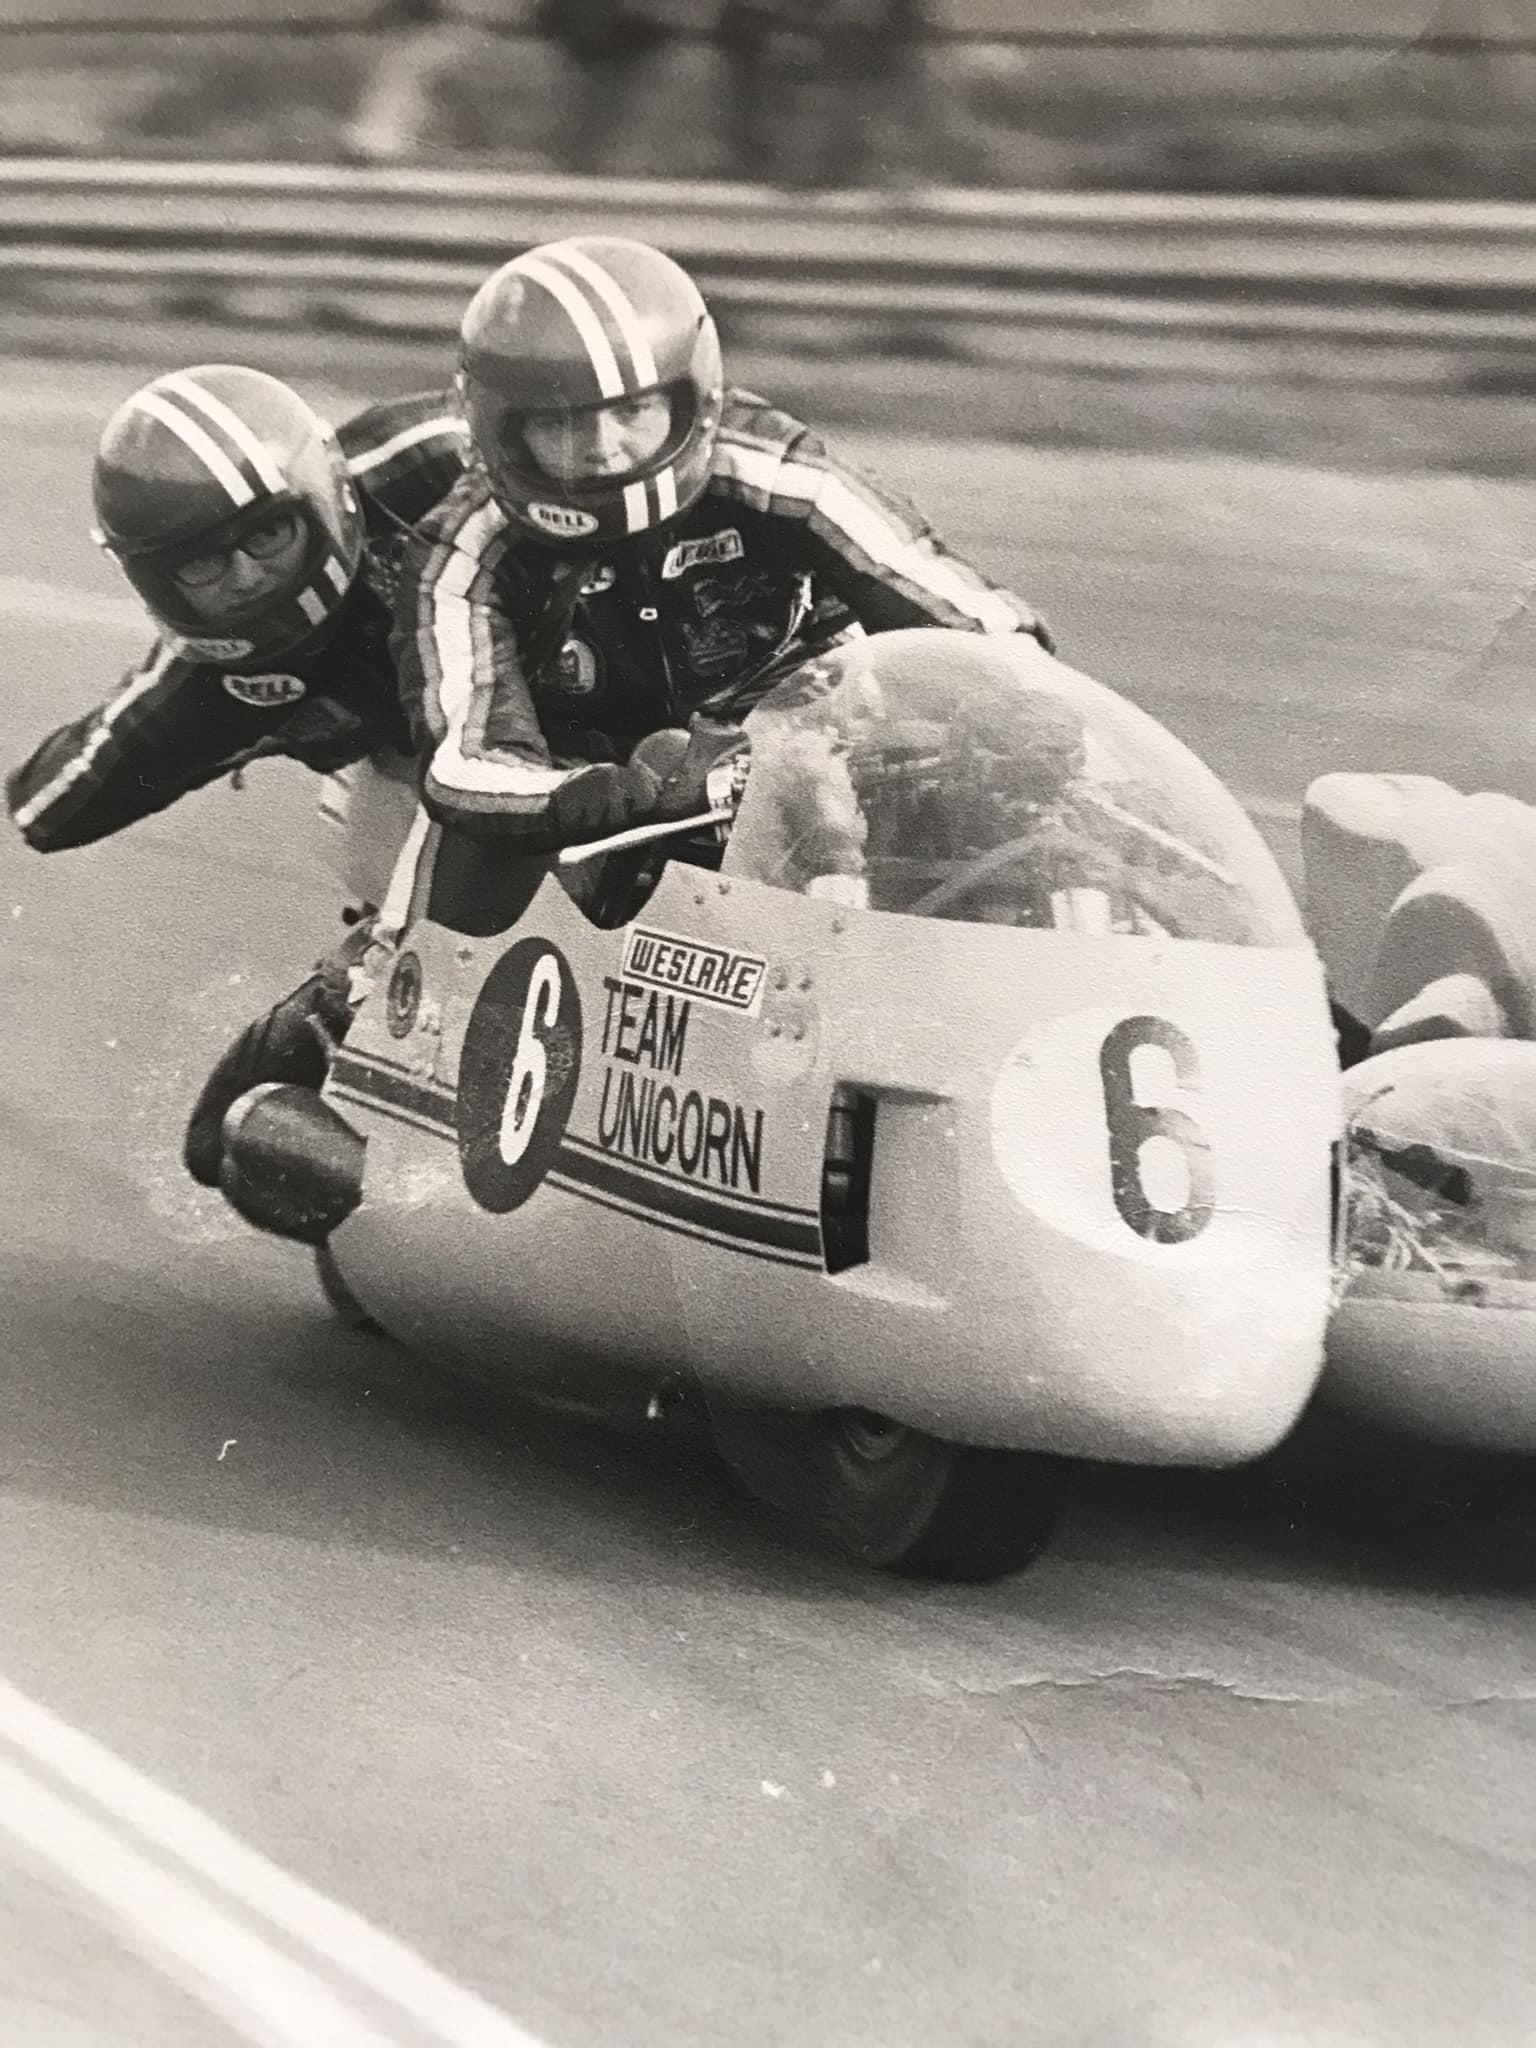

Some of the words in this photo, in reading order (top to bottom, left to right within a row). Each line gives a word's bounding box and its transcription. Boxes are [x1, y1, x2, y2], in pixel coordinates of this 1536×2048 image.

[602, 976, 690, 1076] TEAM
[630, 938, 757, 1000] WESLAKE
[500, 954, 561, 1164] 6
[598, 1067, 764, 1192] UNICORN
[1099, 1015, 1215, 1243] 6
